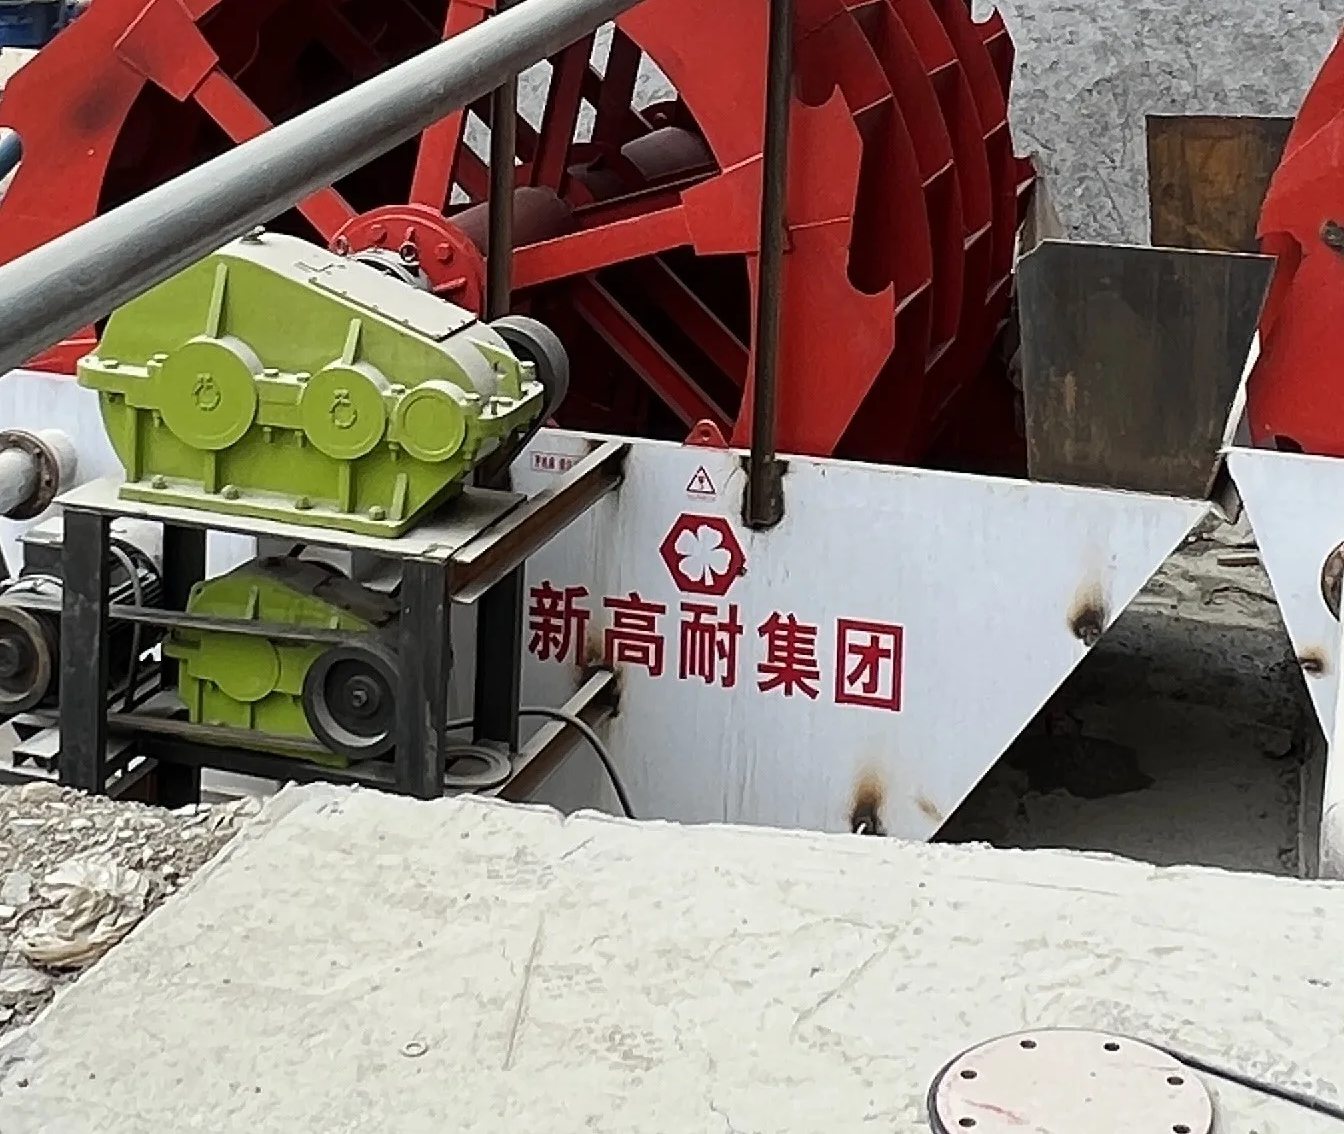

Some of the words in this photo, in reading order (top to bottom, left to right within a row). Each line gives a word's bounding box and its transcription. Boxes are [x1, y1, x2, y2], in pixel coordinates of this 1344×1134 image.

[528, 580, 904, 712] 新高耐集团
